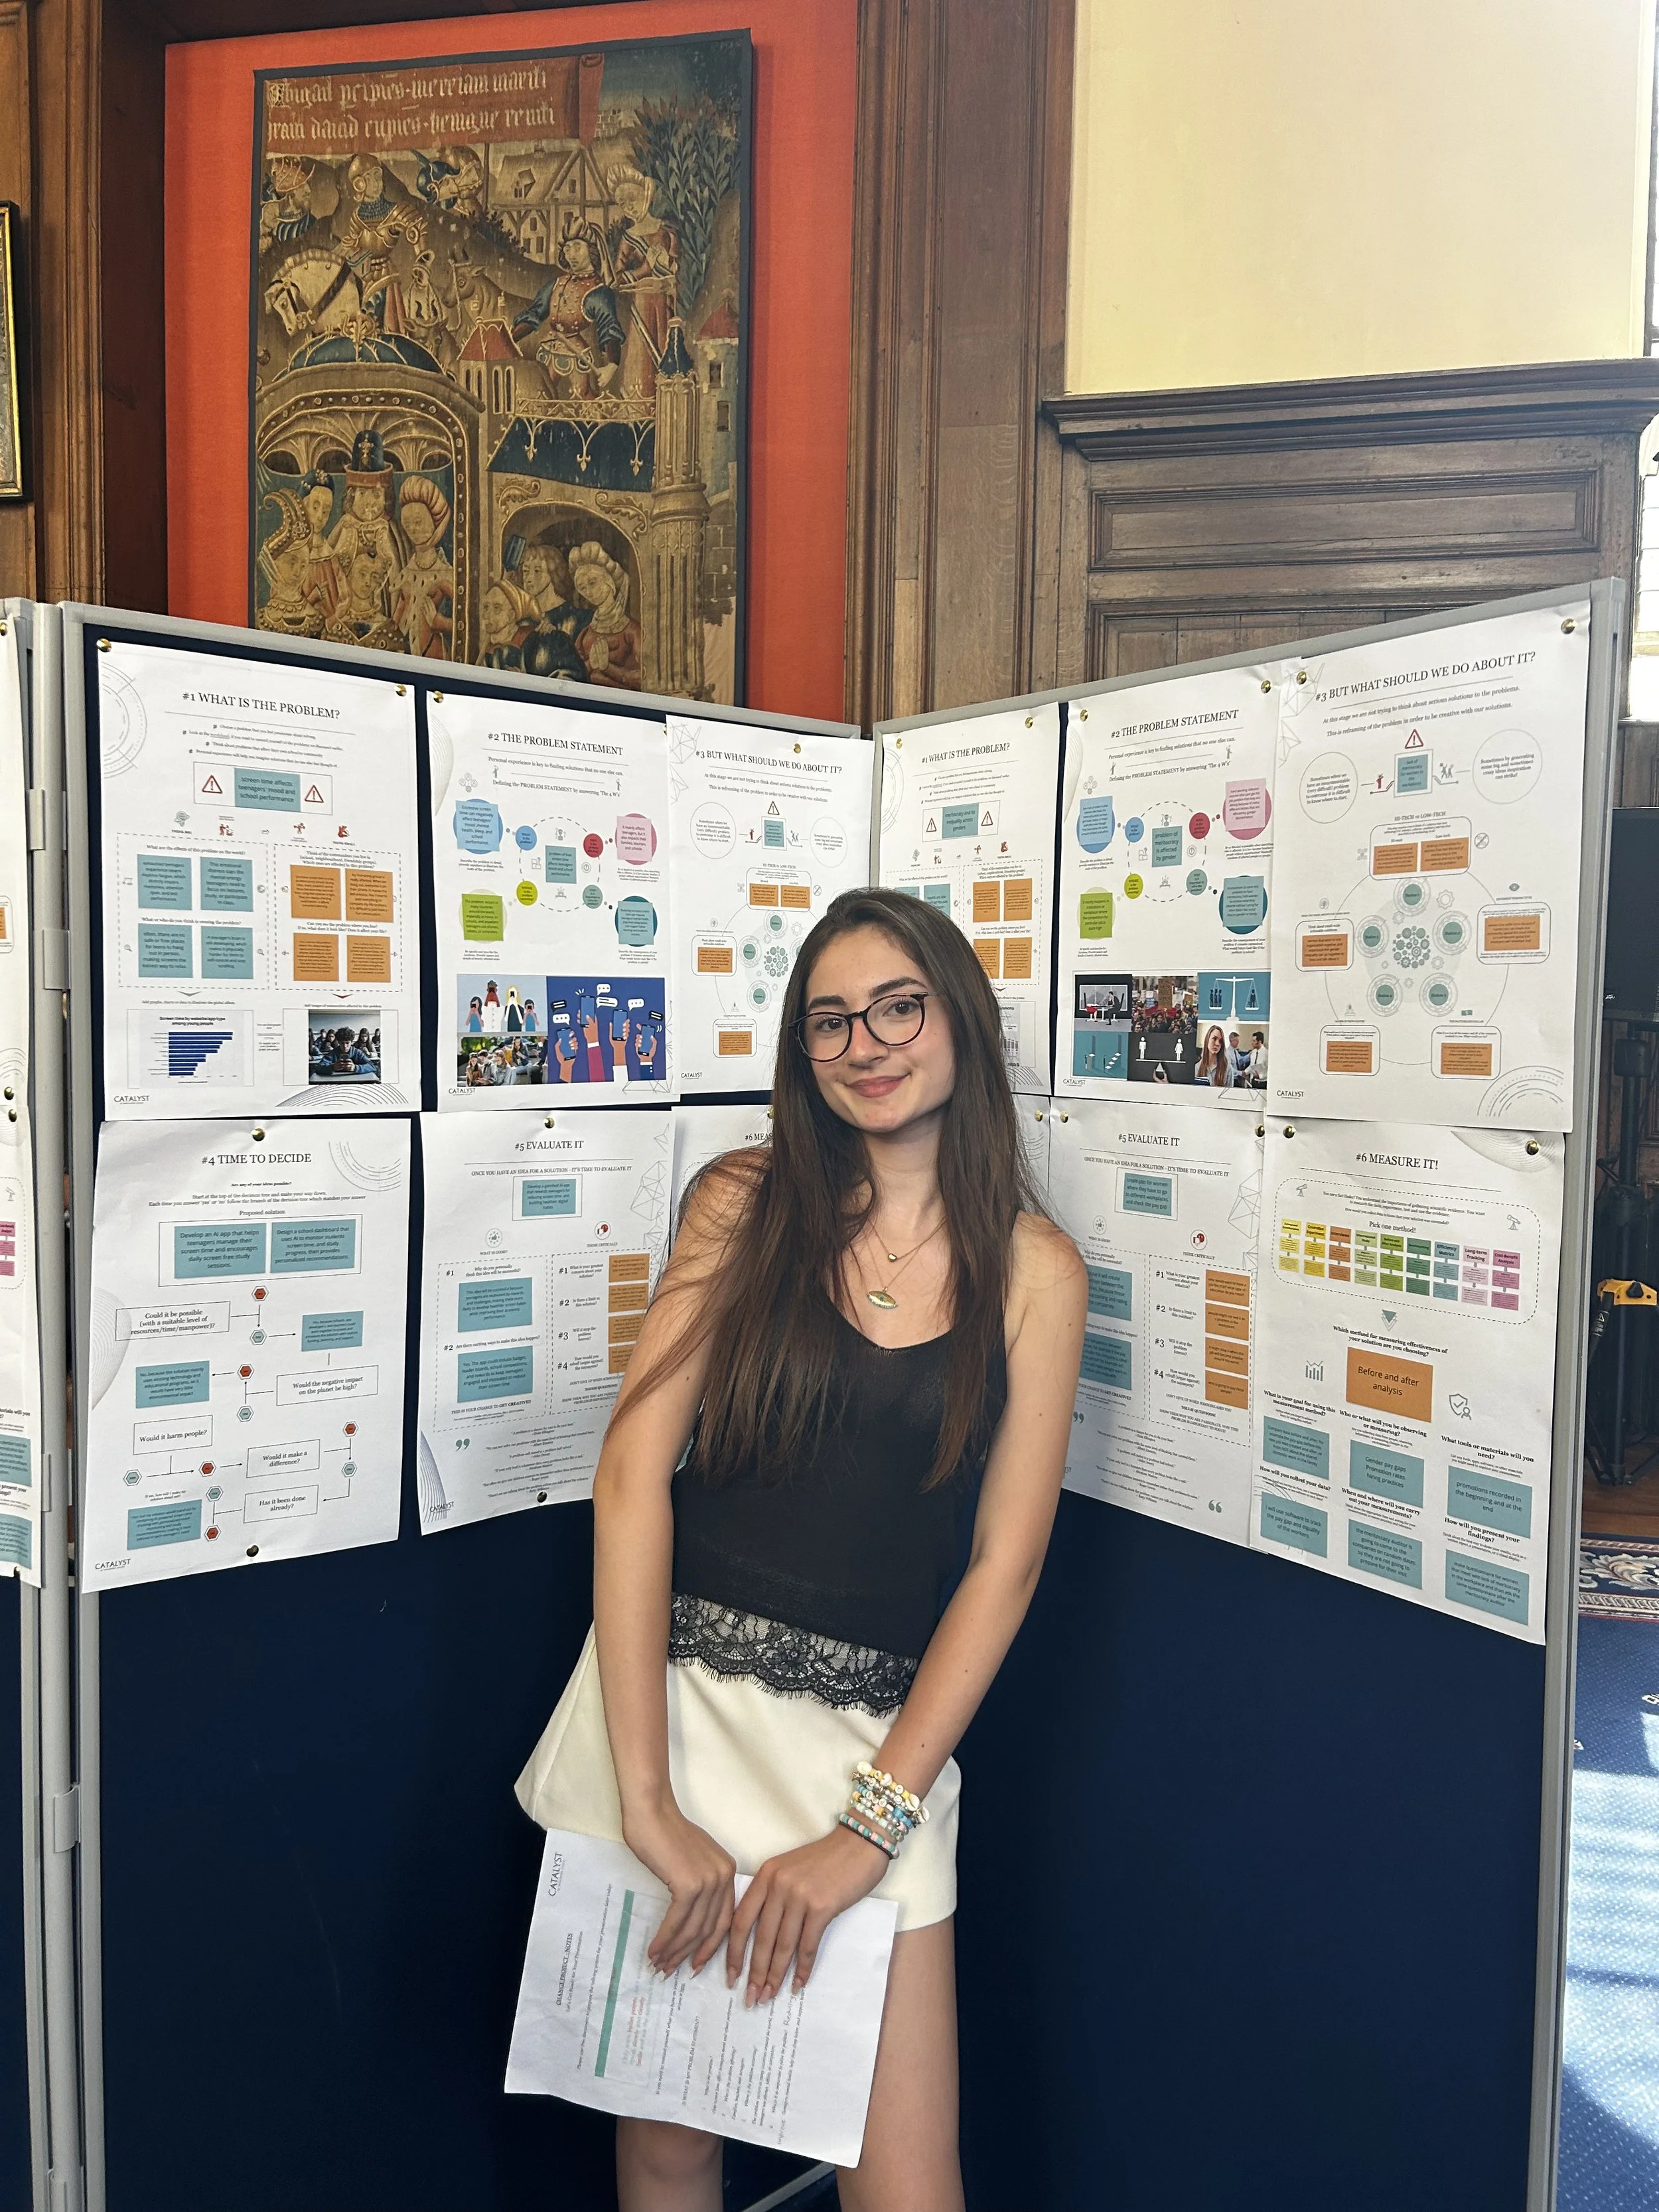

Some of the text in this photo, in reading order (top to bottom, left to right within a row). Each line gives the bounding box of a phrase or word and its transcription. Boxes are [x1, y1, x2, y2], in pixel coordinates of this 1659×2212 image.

[1315, 651, 1536, 702] #3 BUT WHAT SHOULD WE DO ABOUT IT?
[183, 692, 340, 719] #1 WHAT IS THE PROBLEM?
[1121, 725, 1137, 737] THE
[1139, 718, 1179, 733] PROBLEM
[1181, 709, 1239, 726] STATEMENT
[501, 733, 521, 743] THE
[524, 735, 568, 749] PROBLEM
[570, 741, 624, 755] STATEMENT
[929, 752, 948, 762] WHAT
[956, 748, 970, 758] THE
[972, 742, 1010, 755] PROBLEM?
[707, 750, 721, 759] BUT
[724, 752, 747, 762] WHAT
[748, 755, 777, 767] SHOULD
[778, 759, 790, 769] WE
[791, 761, 801, 770] DO
[803, 763, 828, 773] ABOUT
[515, 1143, 524, 1151] #5
[526, 1140, 572, 1149] EVALUATE
[1118, 1134, 1179, 1146] #5 EVALUATE IT
[202, 1153, 311, 1166] #4 TIME TO DECIDE
[1355, 1152, 1438, 1169] #6 MEASURE IT!
[1466, 1254, 1485, 1264] Tracking
[1155, 1270, 1163, 1278] #1
[1156, 1304, 1165, 1313] #2
[130, 1323, 216, 1335] resources/time/manpower)?
[558, 1331, 568, 1341] #3
[1155, 1337, 1164, 1348] #3
[1378, 1336, 1406, 1345] measuring
[1406, 1342, 1441, 1352] effectiveness
[1402, 1347, 1429, 1357] choosing?
[557, 1362, 567, 1370] #4
[1154, 1369, 1163, 1379] #4
[1358, 1366, 1419, 1386] Before and after
[1372, 1383, 1402, 1396] analysis
[184, 1429, 207, 1438] people?
[1441, 1435, 1457, 1443] What
[1480, 1446, 1509, 1456] materials
[269, 1458, 300, 1467] difference?
[429, 1501, 455, 1512] CATALYST
[95, 1558, 131, 1570] CATALYST
[548, 1852, 563, 1896] CATALYST
